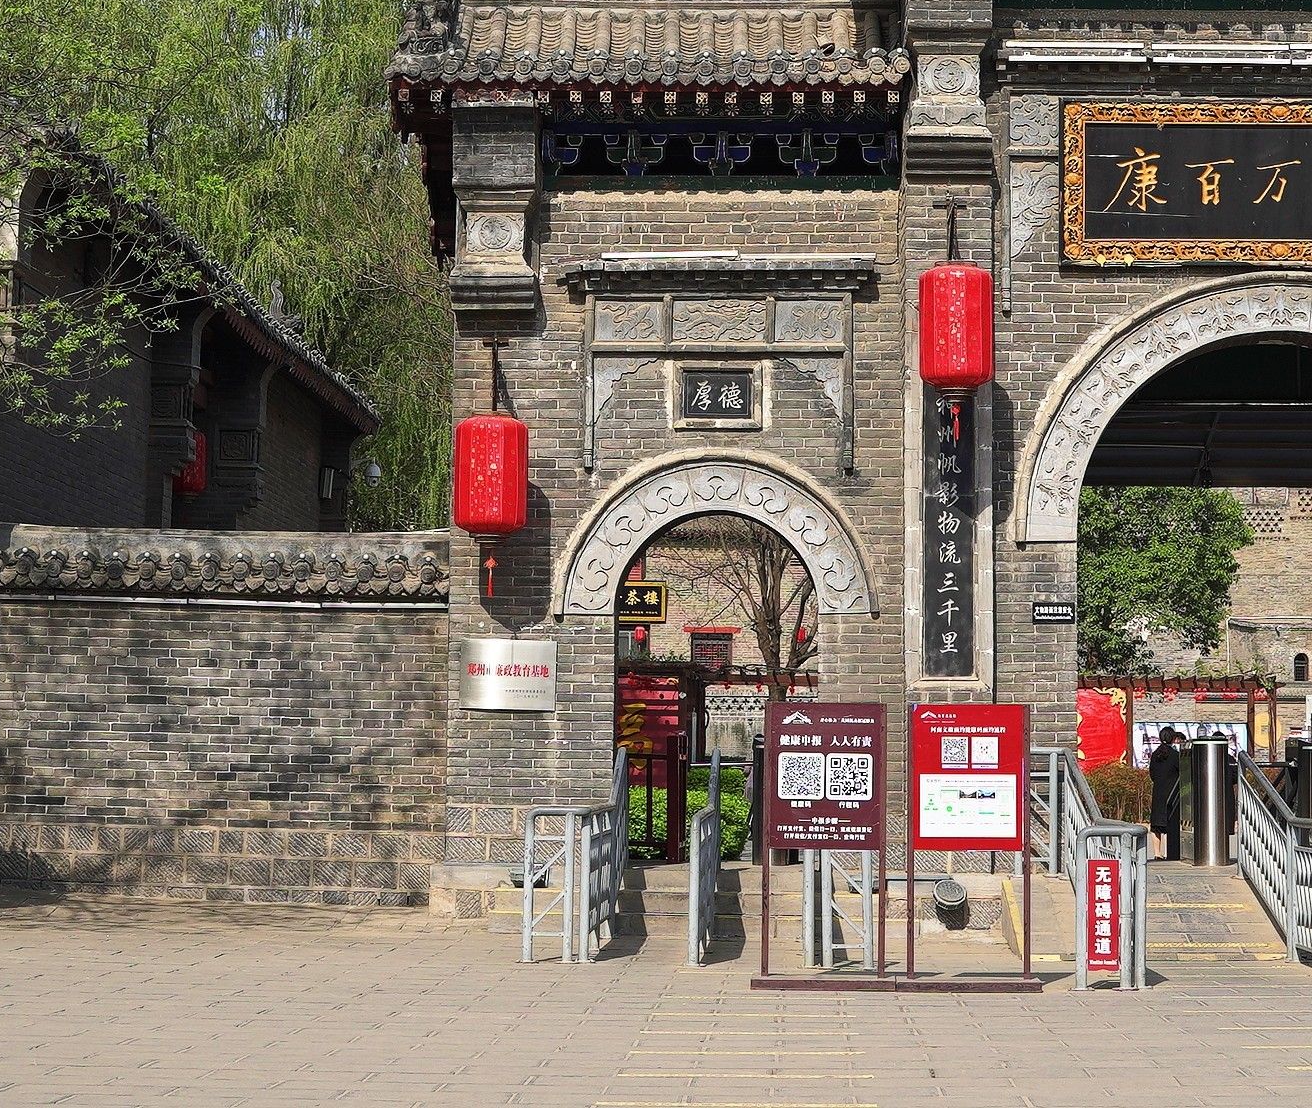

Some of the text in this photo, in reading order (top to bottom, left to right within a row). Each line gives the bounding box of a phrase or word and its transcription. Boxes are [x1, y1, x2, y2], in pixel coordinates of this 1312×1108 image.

[691, 380, 744, 411] 厚德
[779, 734, 872, 748] 健康申报 人人有责
[1094, 866, 1112, 955] 无障碍通道
